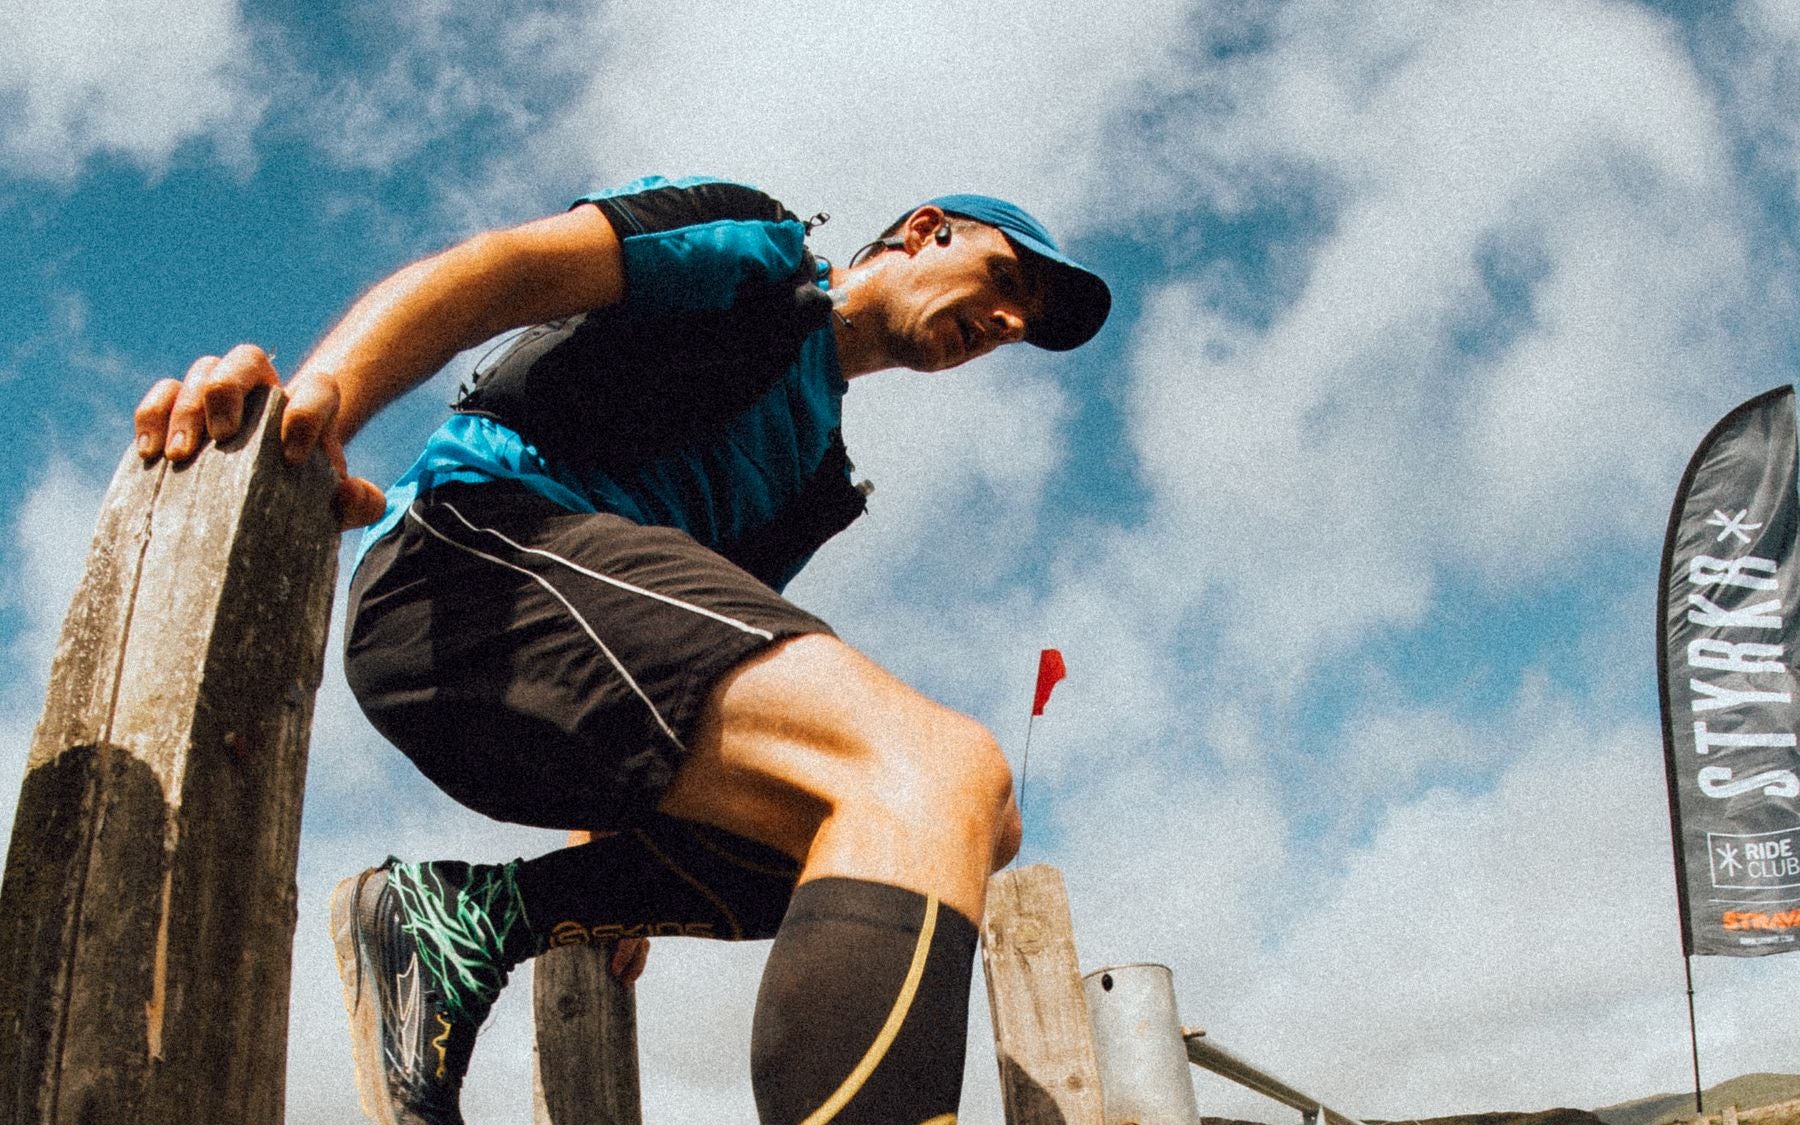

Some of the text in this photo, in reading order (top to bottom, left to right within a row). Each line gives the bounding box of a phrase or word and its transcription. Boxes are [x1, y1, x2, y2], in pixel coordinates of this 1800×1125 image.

[1687, 555, 1800, 798] STYRKR
[1745, 839, 1793, 860] RIDE
[1747, 857, 1800, 878] CLUB
